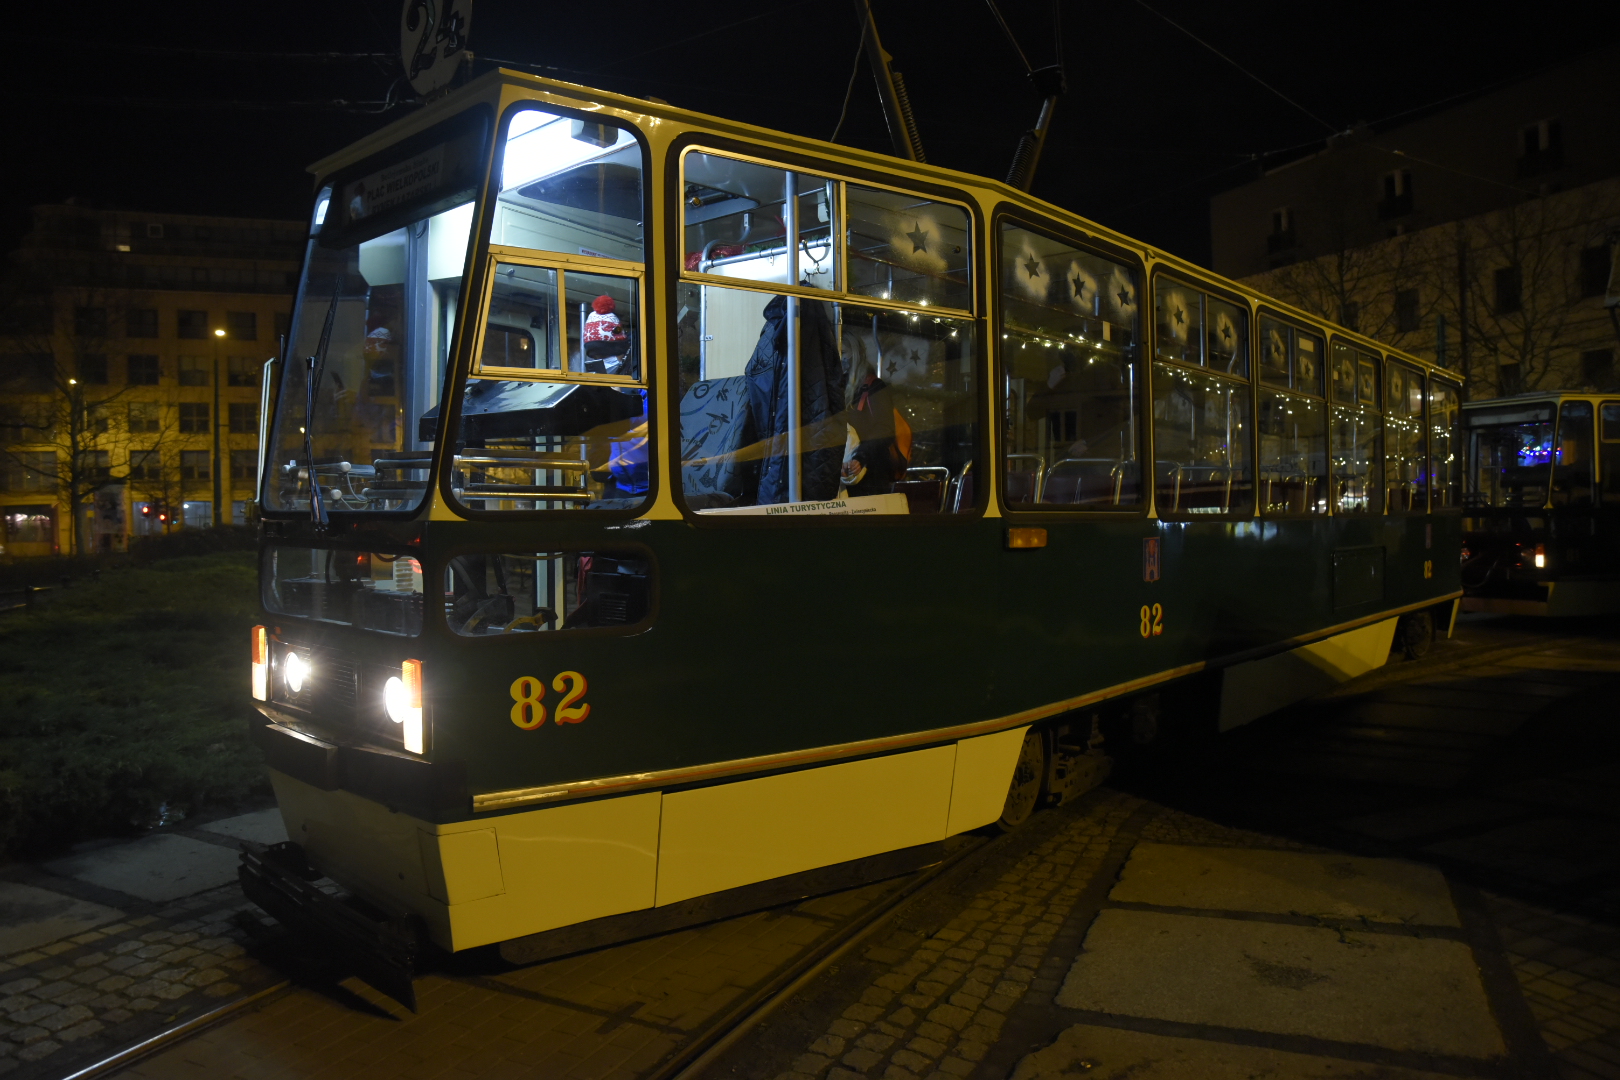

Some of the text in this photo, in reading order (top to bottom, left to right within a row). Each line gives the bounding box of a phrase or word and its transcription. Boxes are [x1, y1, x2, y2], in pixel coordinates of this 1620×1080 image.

[406, 0, 465, 80] 24
[366, 185, 385, 203] PLAC
[386, 161, 440, 194] WIELKOPOLSKI
[766, 500, 847, 515] LINIA TURYSTYCZNA
[1140, 603, 1164, 638] 82
[510, 670, 591, 731] 82
